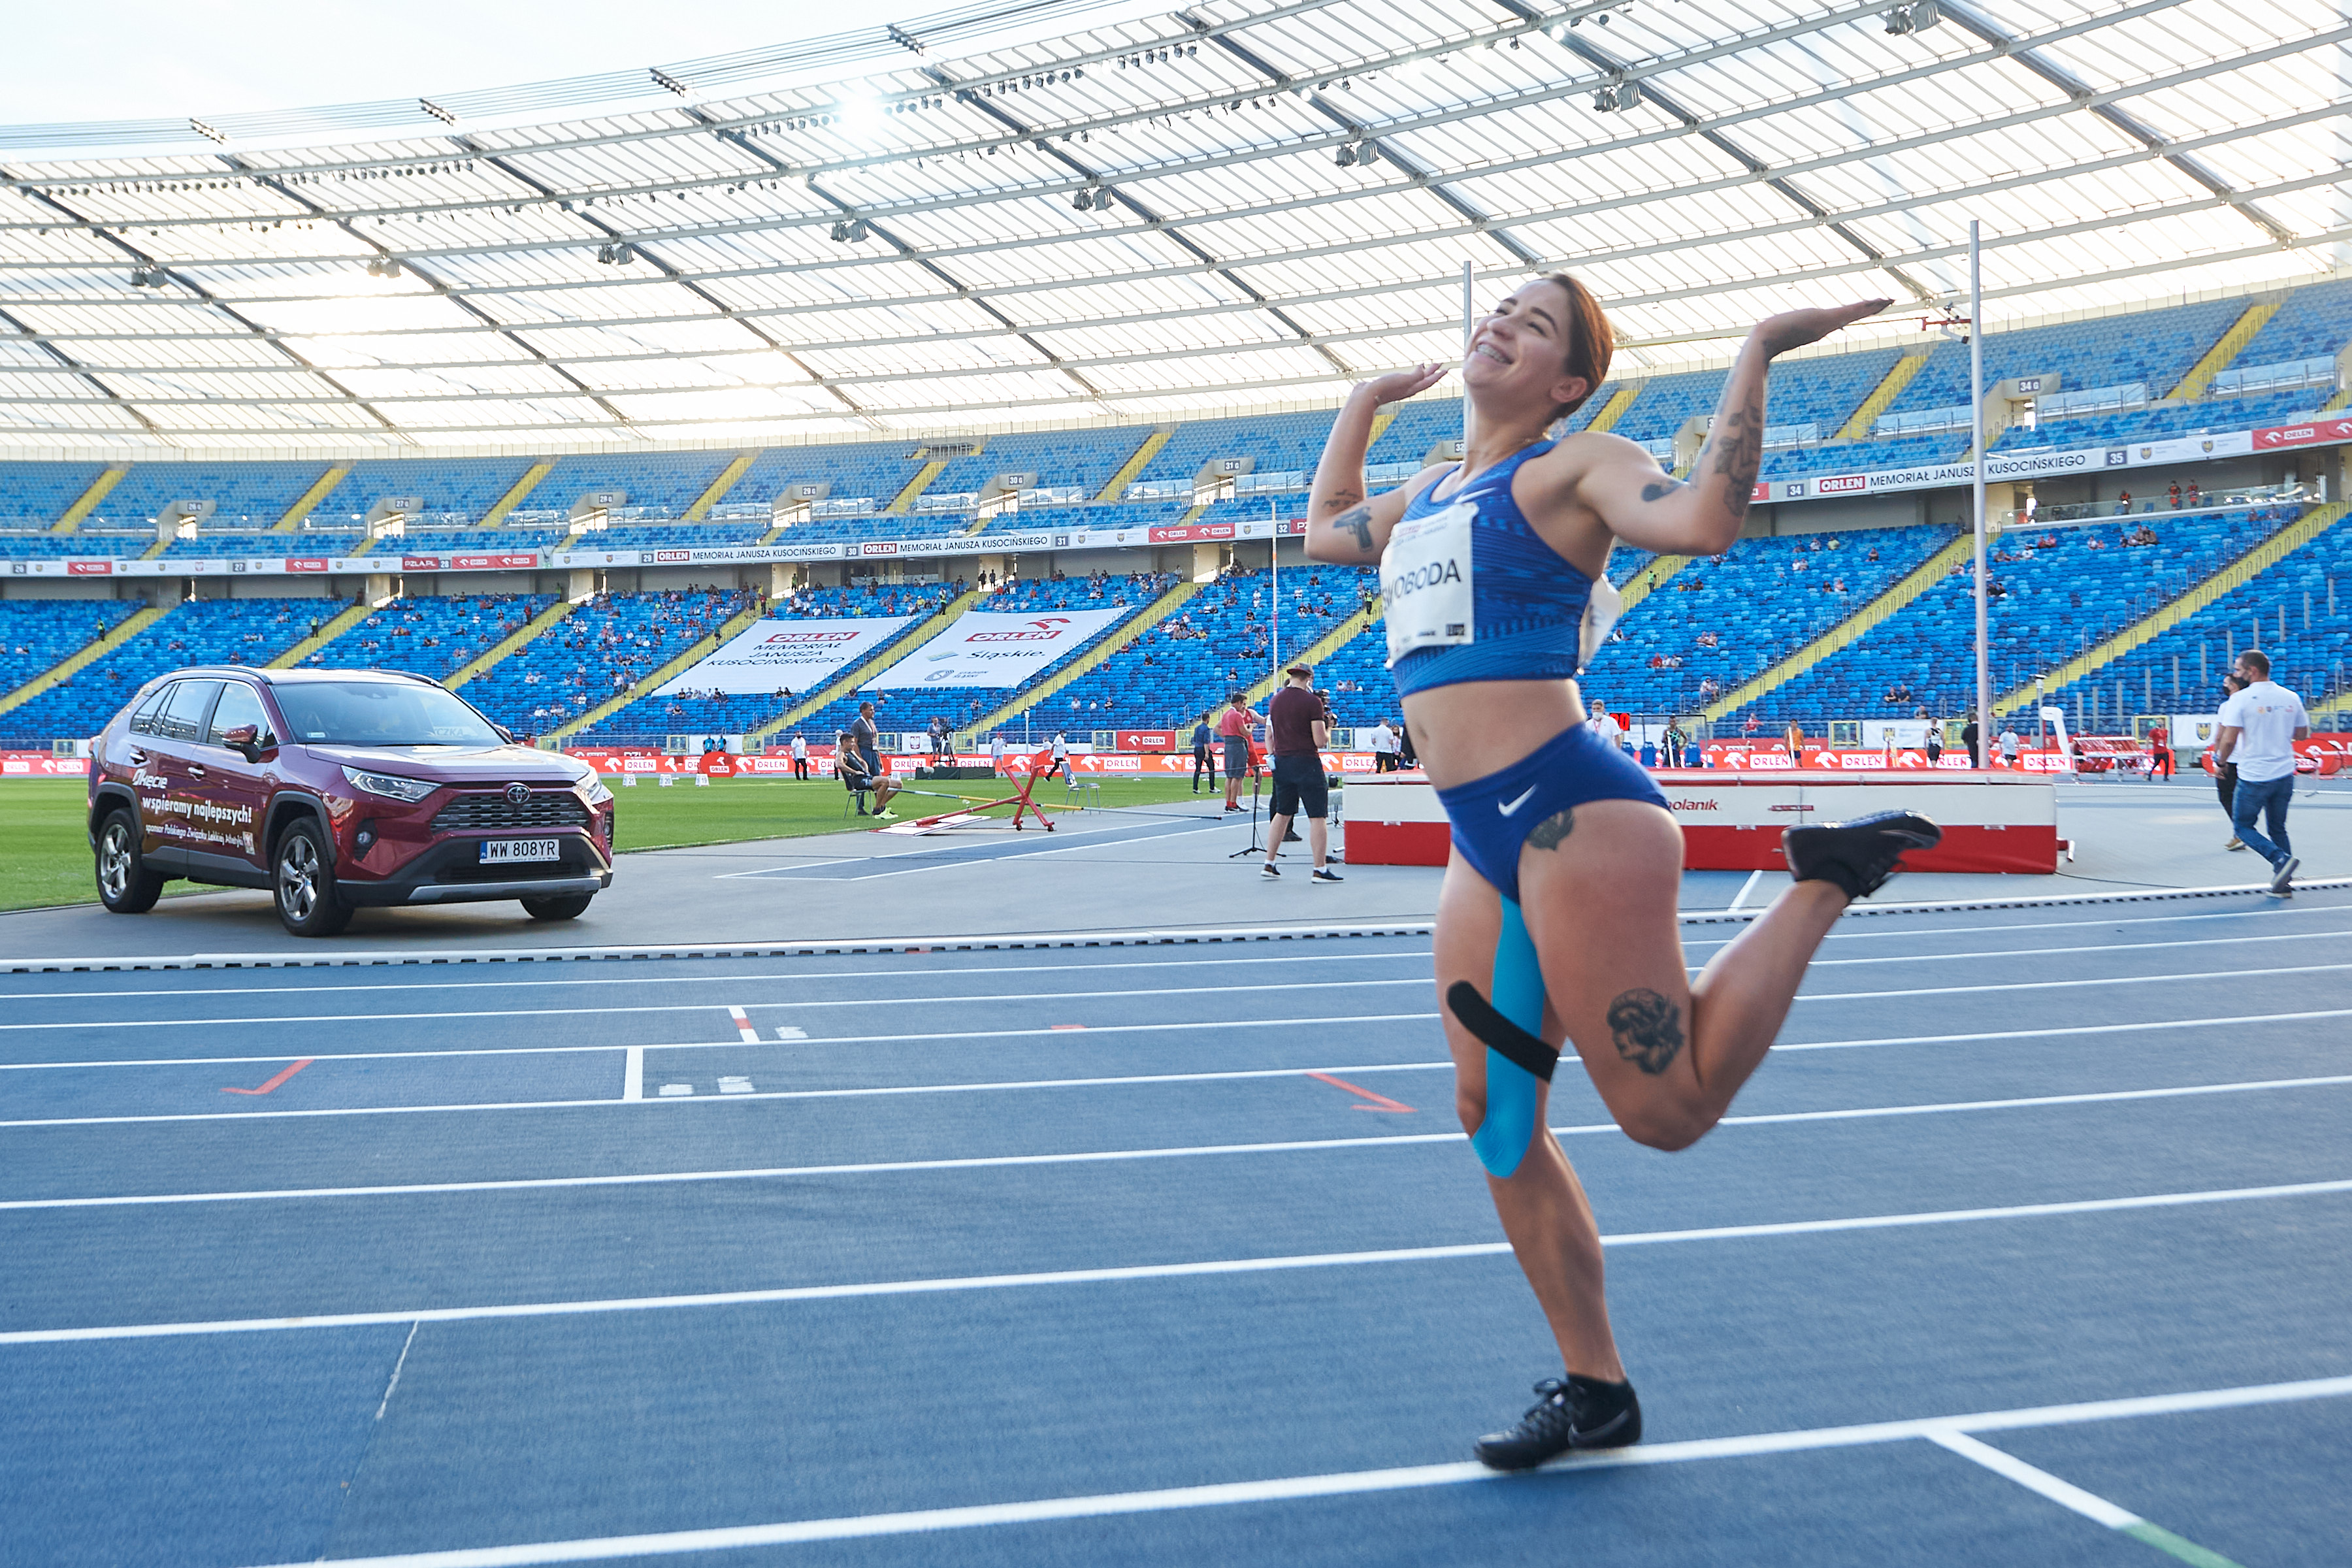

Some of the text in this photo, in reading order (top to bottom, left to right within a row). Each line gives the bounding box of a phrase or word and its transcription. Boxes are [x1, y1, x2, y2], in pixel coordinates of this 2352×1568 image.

[2020, 381, 2032, 391] 34
[2286, 430, 2311, 438] ORLEN
[2110, 453, 2124, 463] 35
[1226, 461, 1233, 470] 31
[1821, 453, 2085, 491] ORLEN MEMORIAŁ JANUSZ KUSOCIŃSKIEGO
[1790, 485, 1801, 495] 34
[865, 536, 1047, 554] ORLEN MEMORIAŁ JANUSZA KUSOCIŃSKIEGO
[1057, 537, 1067, 546] 31
[658, 546, 837, 561] ORLEN MEMORIAŁ JANUSZA KUSOCIŃSKIEGO
[772, 633, 852, 642] ORLEN
[972, 631, 1056, 641] ORLEN
[707, 656, 845, 666] KUSOCIŃSKIEGO
[132, 768, 168, 789] Okęcie
[142, 794, 252, 826] wspieramy najlepszych!
[491, 841, 555, 857] WW 808YR
